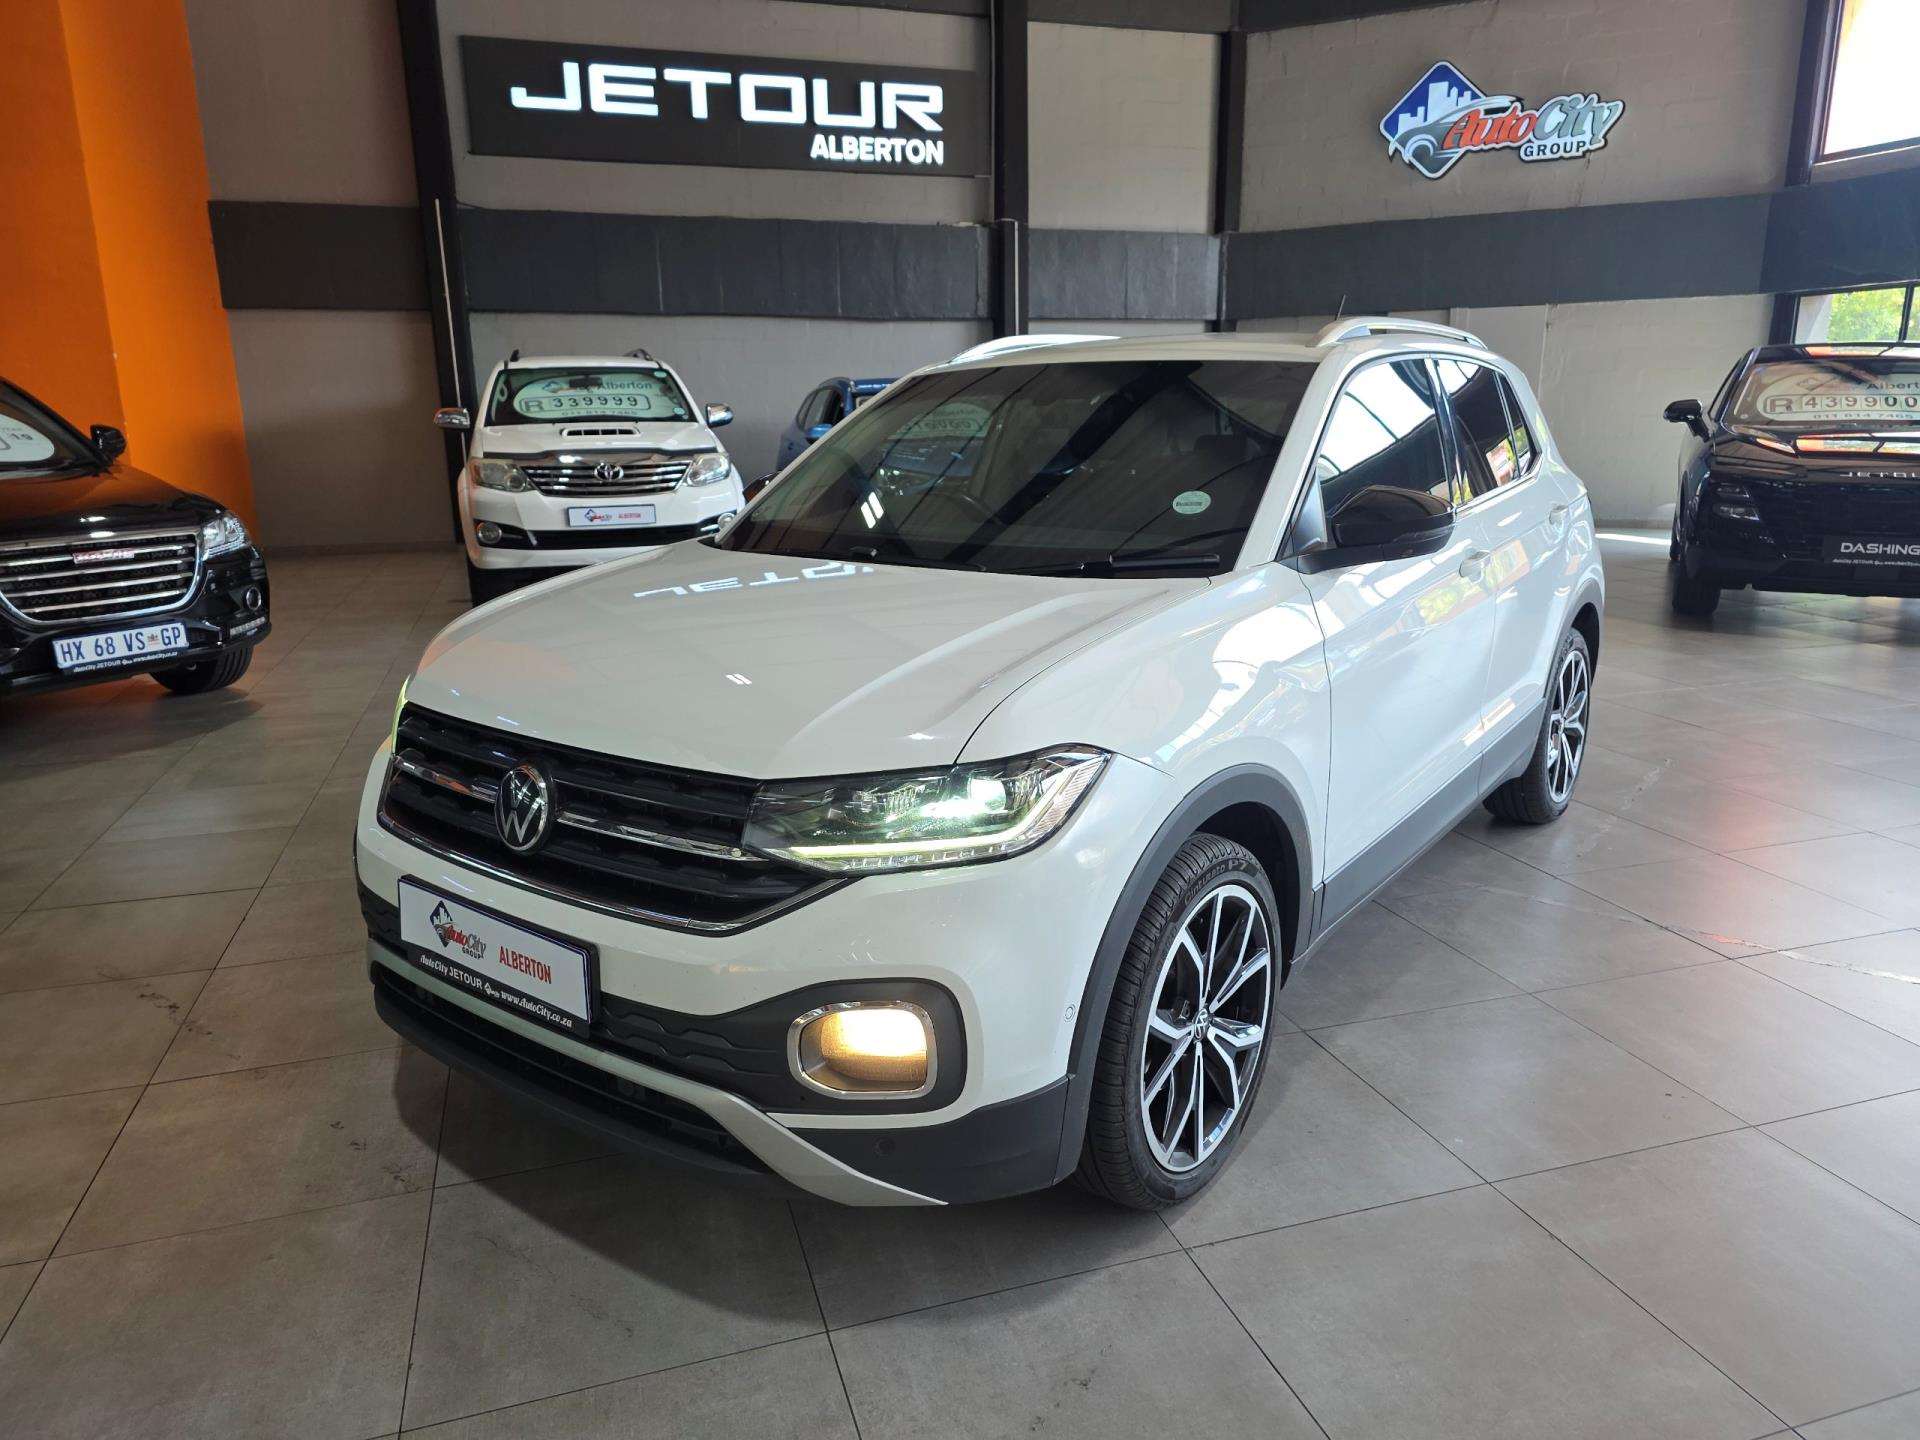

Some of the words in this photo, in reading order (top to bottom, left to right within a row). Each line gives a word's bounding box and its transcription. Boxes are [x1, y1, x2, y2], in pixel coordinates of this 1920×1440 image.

[510, 61, 944, 132] JETOUR
[1443, 96, 1622, 148] AutoCity
[810, 134, 944, 165] ALBERTON
[1523, 140, 1587, 157] GROUP
[553, 395, 638, 408] 339999
[1840, 541, 1920, 556] DASHING
[60, 640, 86, 663] HX
[94, 636, 116, 657] 68
[123, 631, 146, 652] VS
[160, 626, 181, 647] GP
[444, 924, 487, 959] AutoCity
[449, 966, 483, 990] JETOUR
[499, 945, 552, 985] ALBERTON
